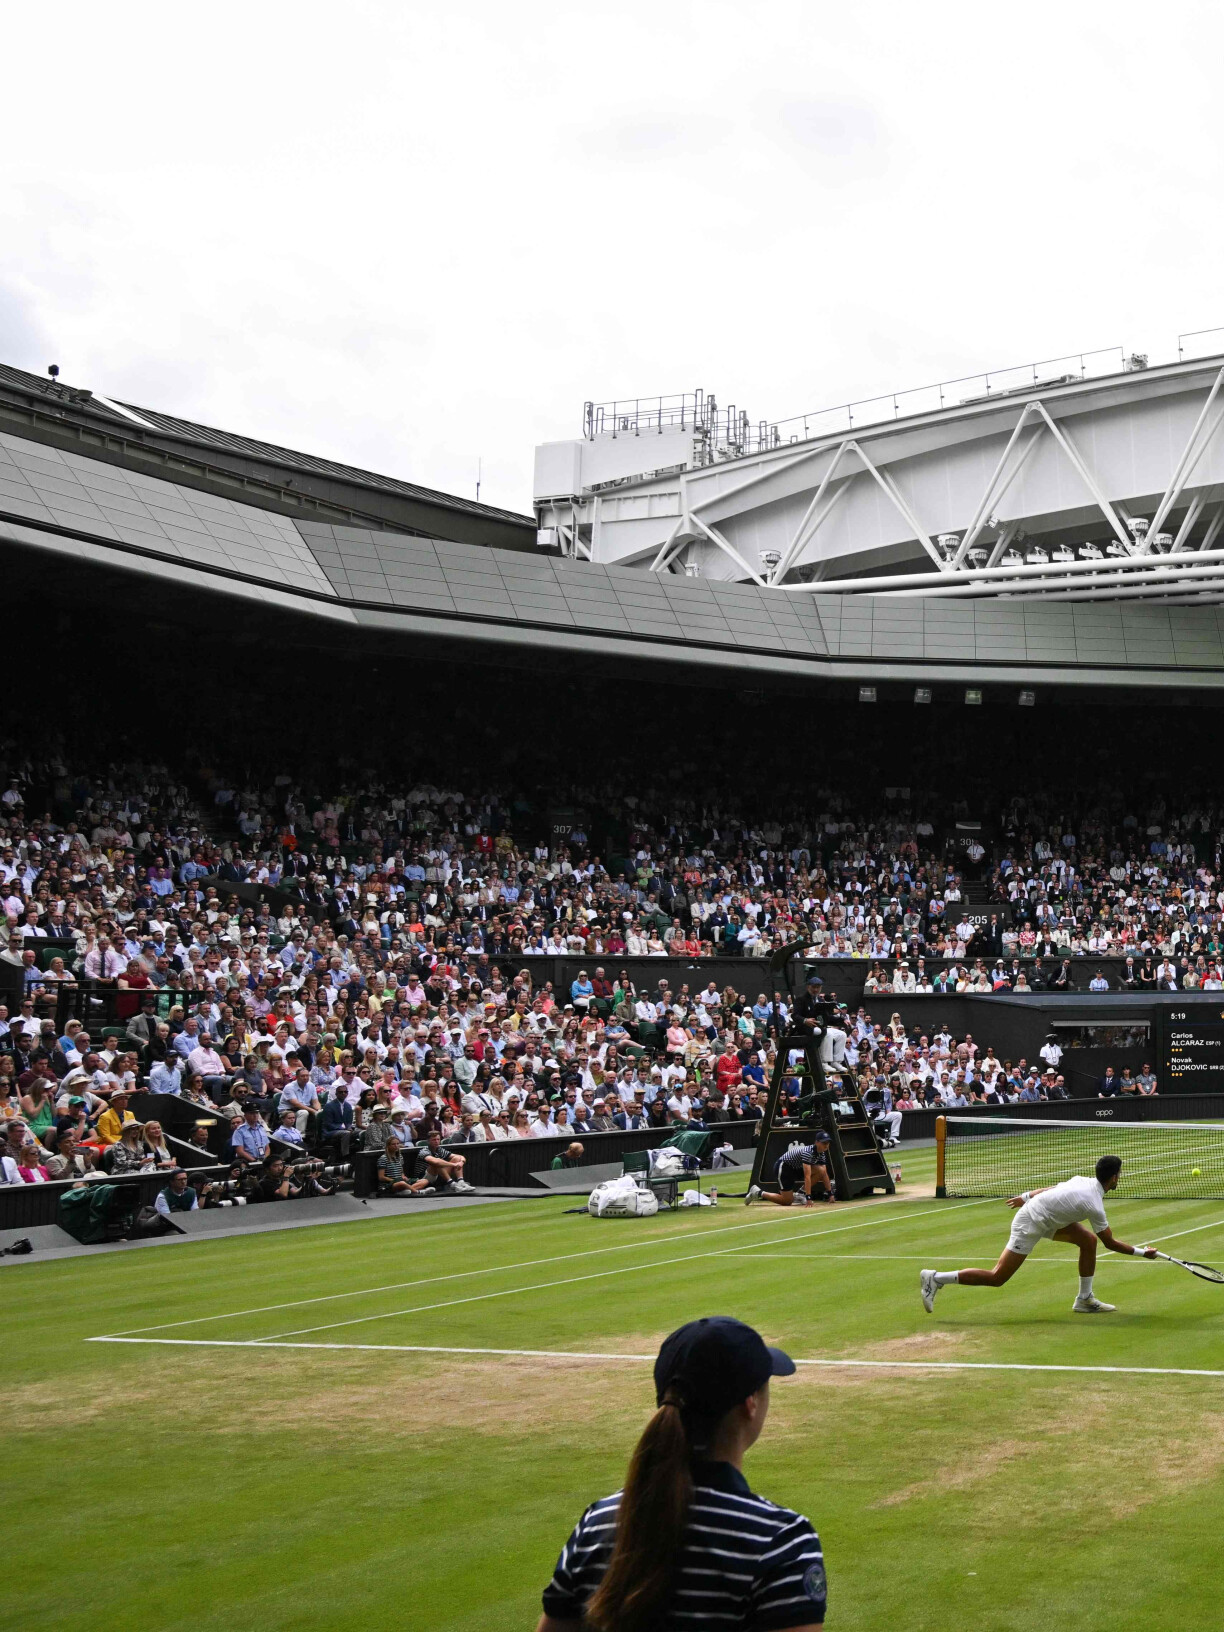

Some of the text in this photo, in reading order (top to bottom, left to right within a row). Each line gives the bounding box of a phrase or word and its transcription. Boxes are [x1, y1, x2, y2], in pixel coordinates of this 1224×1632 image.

[553, 824, 573, 834] 307
[959, 838, 975, 846] 30
[968, 915, 988, 925] 205
[1170, 1012, 1186, 1020] 5:19
[1095, 1109, 1114, 1118] oppo
